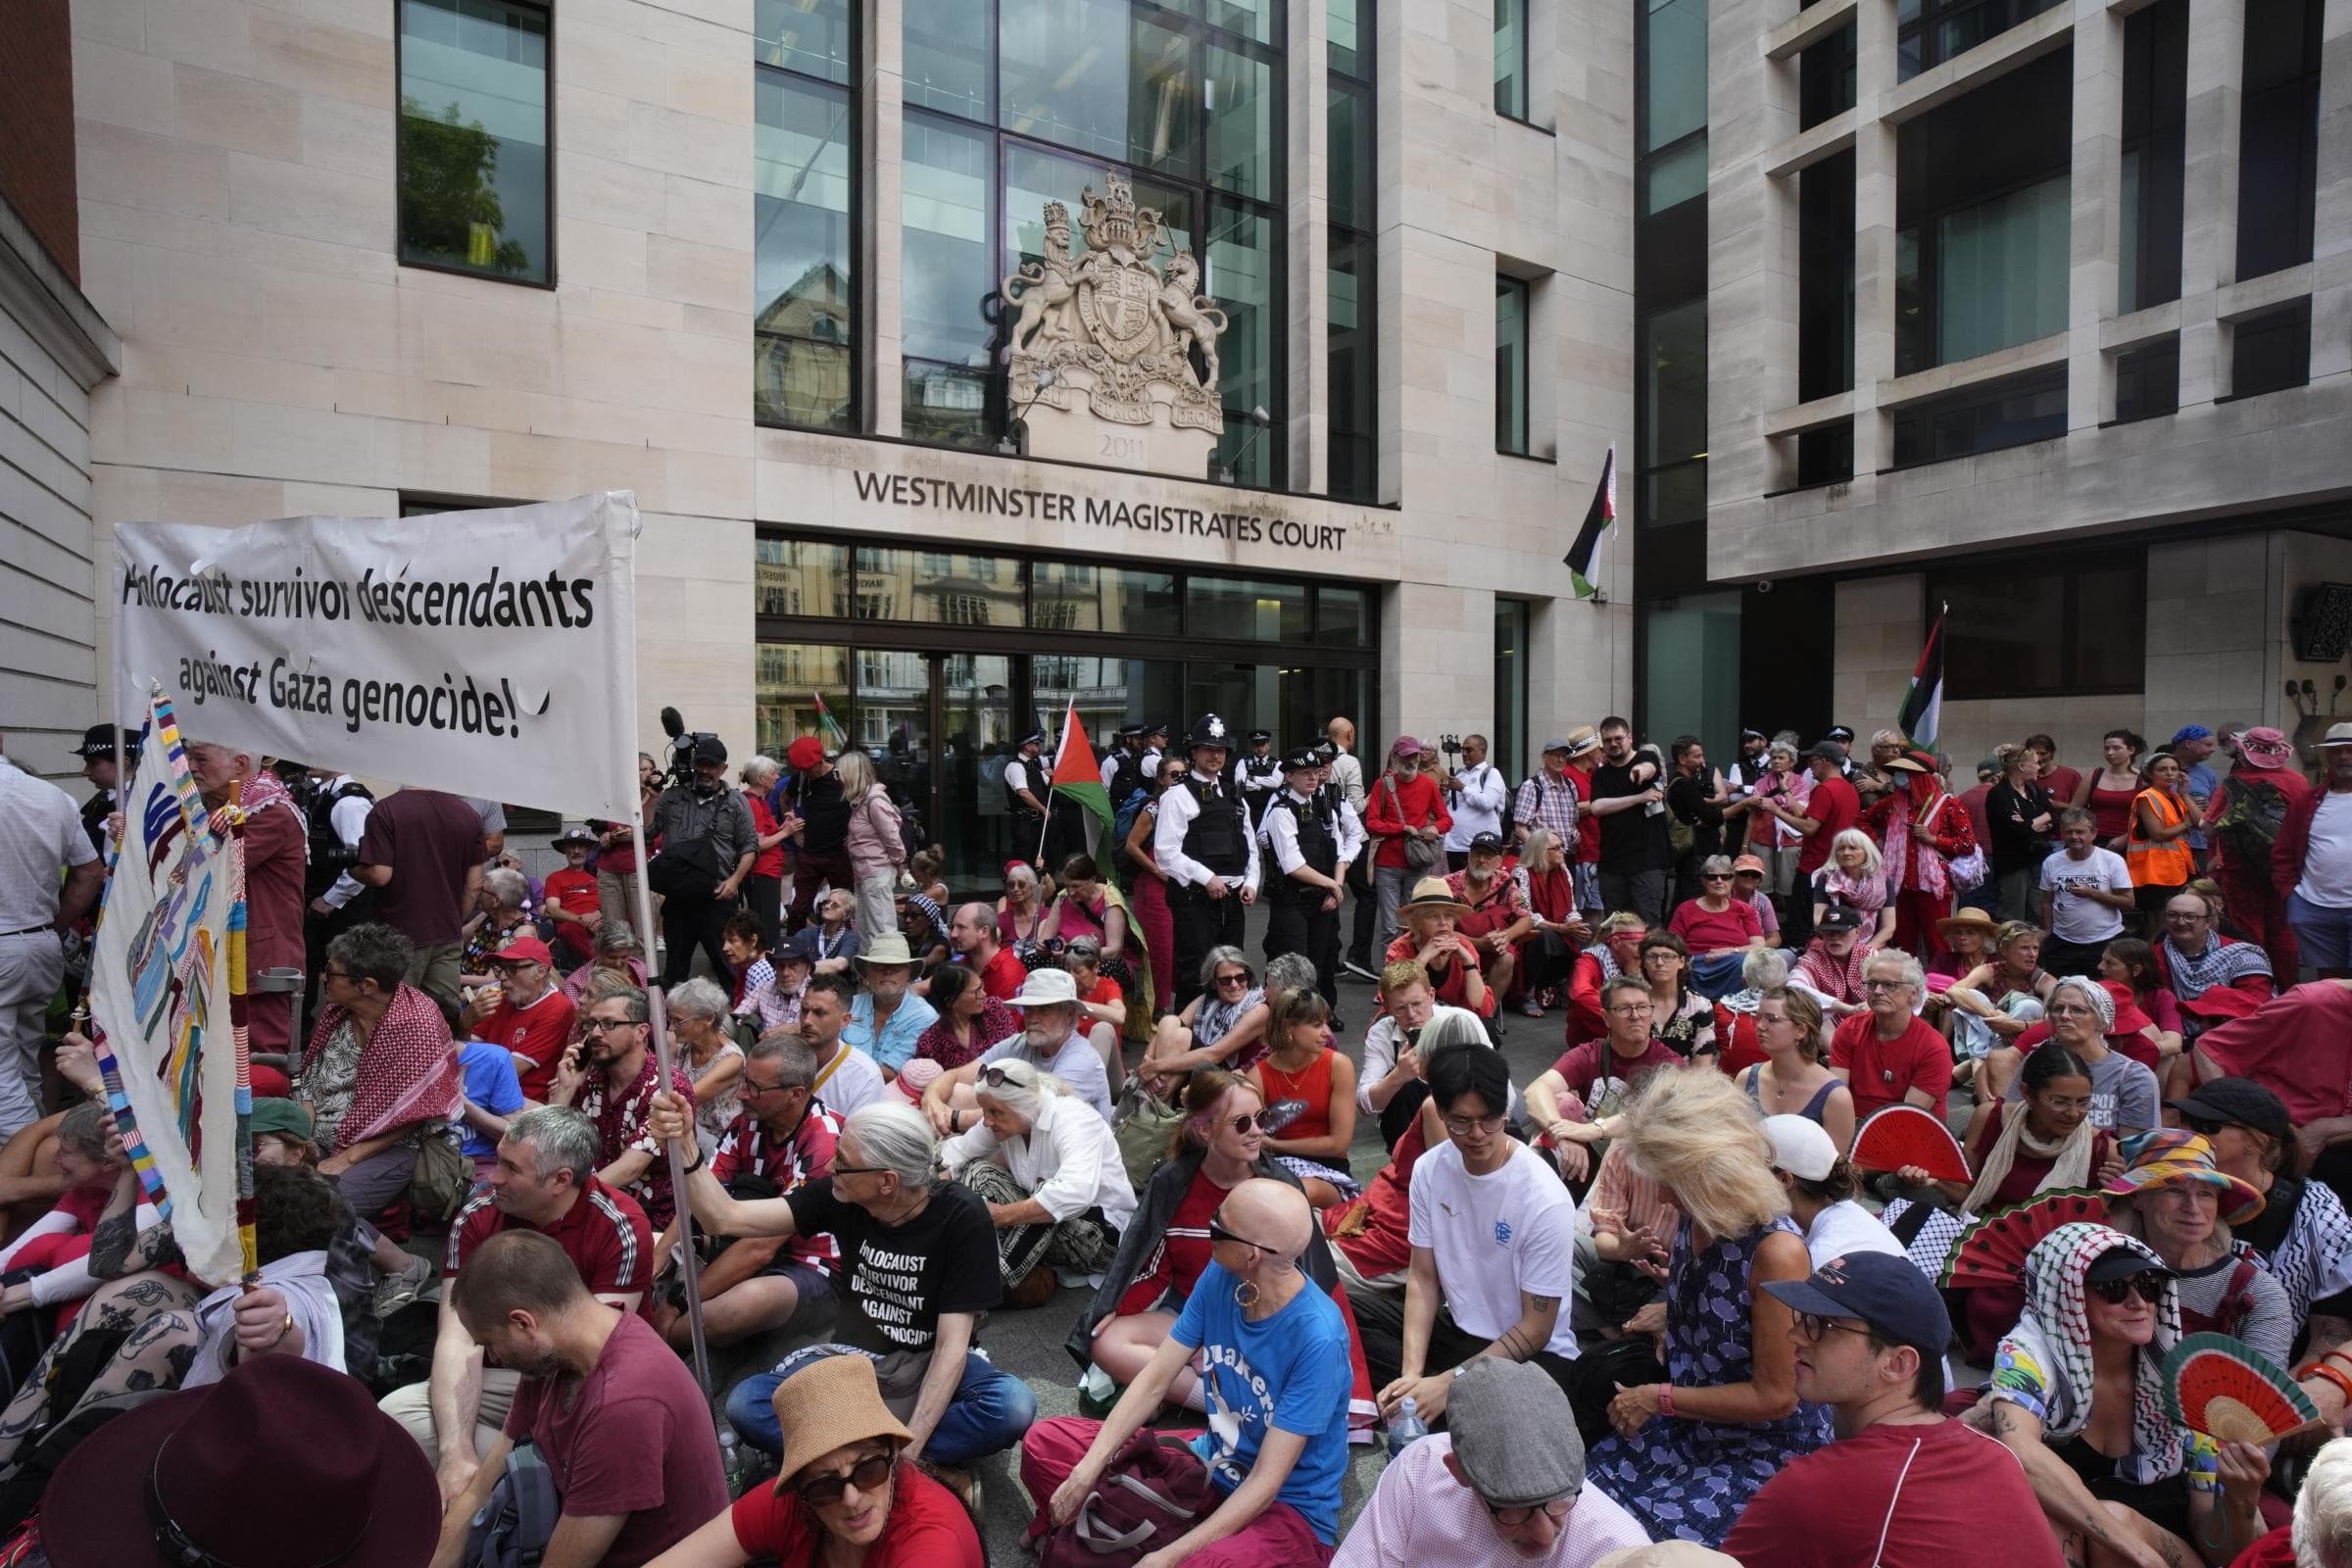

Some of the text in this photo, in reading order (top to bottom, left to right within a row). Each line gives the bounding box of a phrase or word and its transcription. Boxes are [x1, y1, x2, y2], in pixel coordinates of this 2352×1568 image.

[1100, 433, 1145, 462] 2011
[854, 470, 1347, 551] WESTMINSTER MAGISTRATES COURT
[122, 564, 594, 628] Holocaust survivor descendants
[179, 650, 519, 739] against Gaza genocide!
[851, 1274, 924, 1310] DESCENDANT
[858, 1262, 918, 1292] SURVIVOR
[862, 1298, 912, 1325] AGAINST
